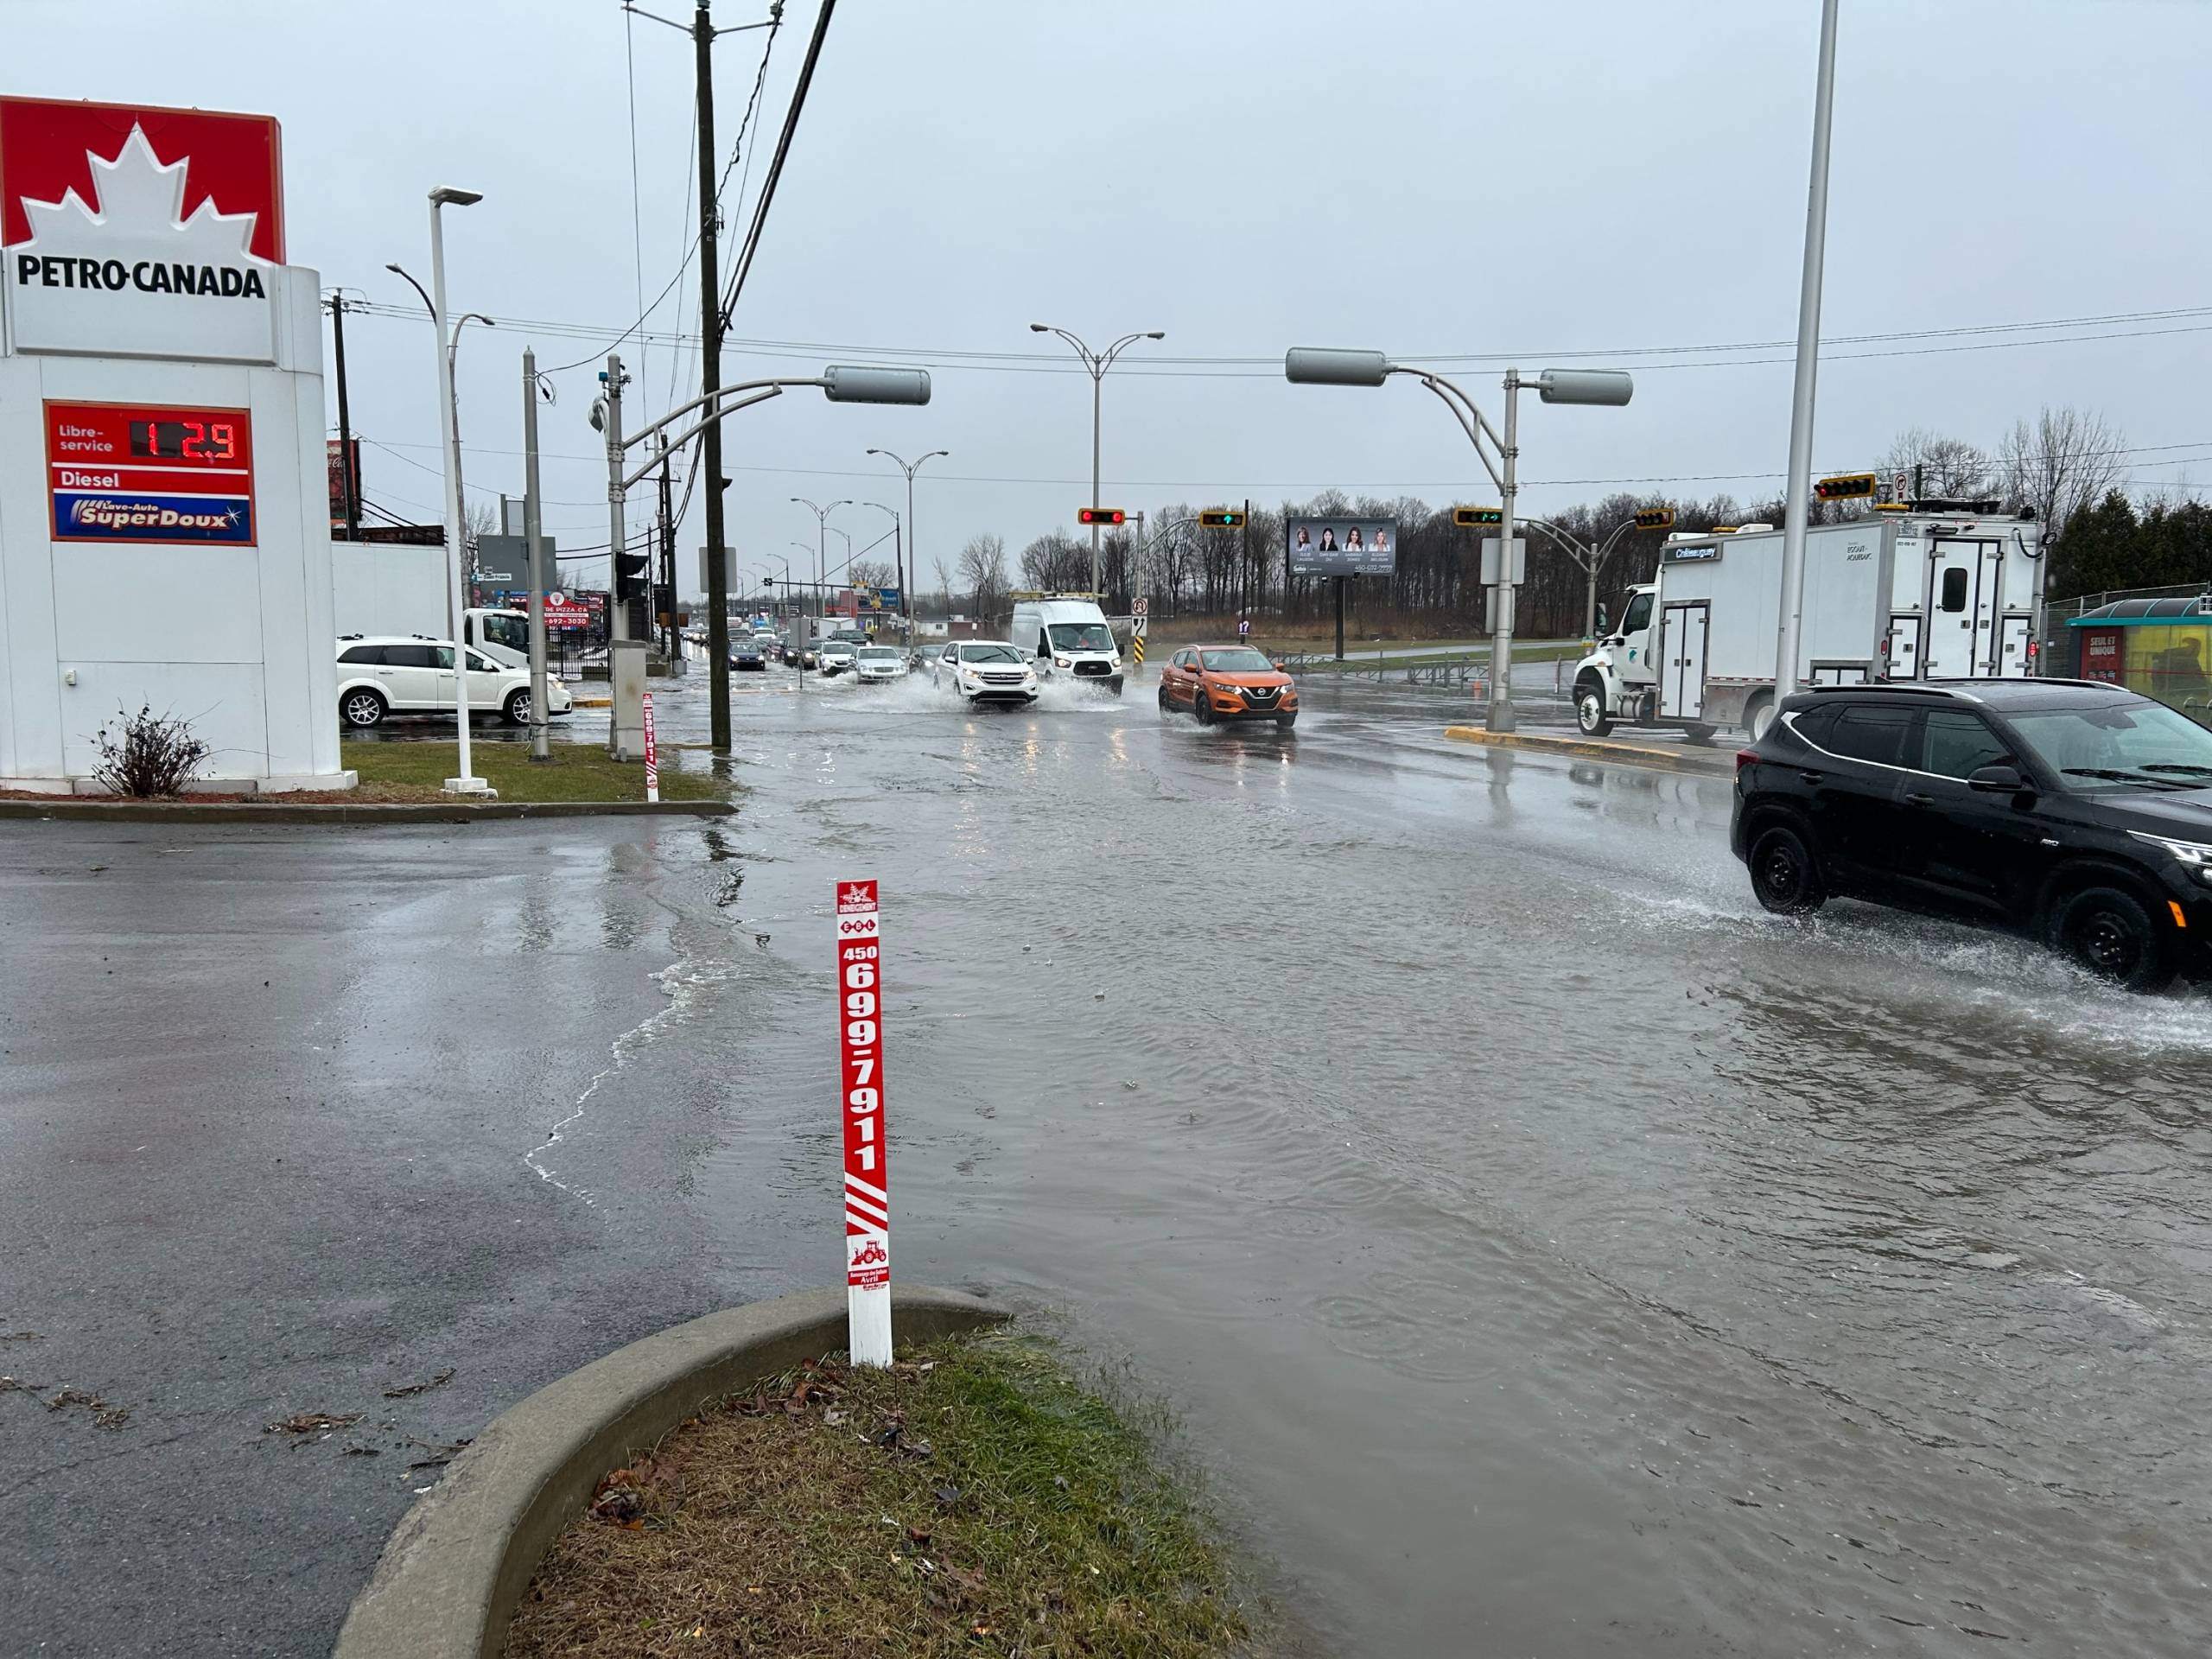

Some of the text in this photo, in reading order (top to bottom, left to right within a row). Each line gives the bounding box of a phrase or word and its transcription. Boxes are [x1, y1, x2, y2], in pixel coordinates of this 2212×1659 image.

[59, 424, 105, 438] Libre-
[60, 439, 113, 453] service
[60, 470, 120, 488] Diesel
[102, 502, 159, 512] Lave-Auto
[79, 508, 229, 530] SuperDoux
[2090, 636, 2115, 646] SEUL ET
[2089, 646, 2115, 656] UNIQUE
[842, 945, 878, 961] 450
